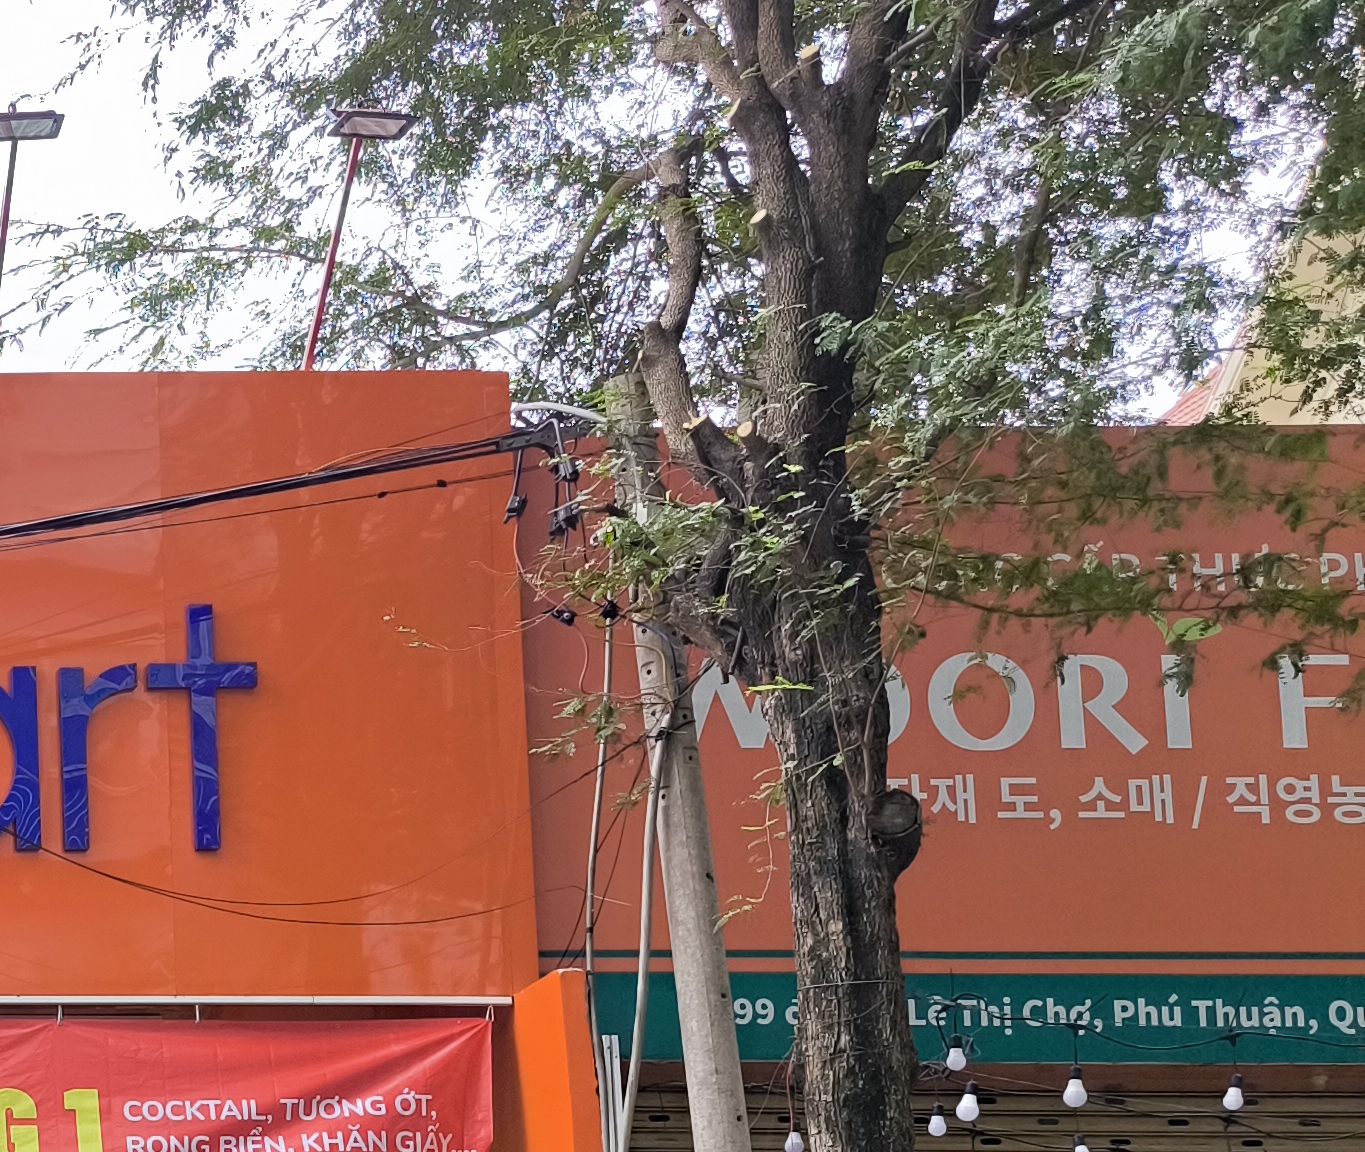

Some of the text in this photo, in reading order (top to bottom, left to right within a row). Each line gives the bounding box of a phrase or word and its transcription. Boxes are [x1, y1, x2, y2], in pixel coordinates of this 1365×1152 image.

[997, 776, 1062, 831] 도,
[1078, 773, 1175, 824] 소매
[733, 998, 775, 1026] 99
[961, 999, 1013, 1034] Thị
[1021, 998, 1104, 1034] Chợ,
[1114, 995, 1182, 1028] Phú
[1191, 997, 1319, 1035] Thuận,
[122, 1087, 438, 1126] COCKTAIL, TƯƠNG ỚT,
